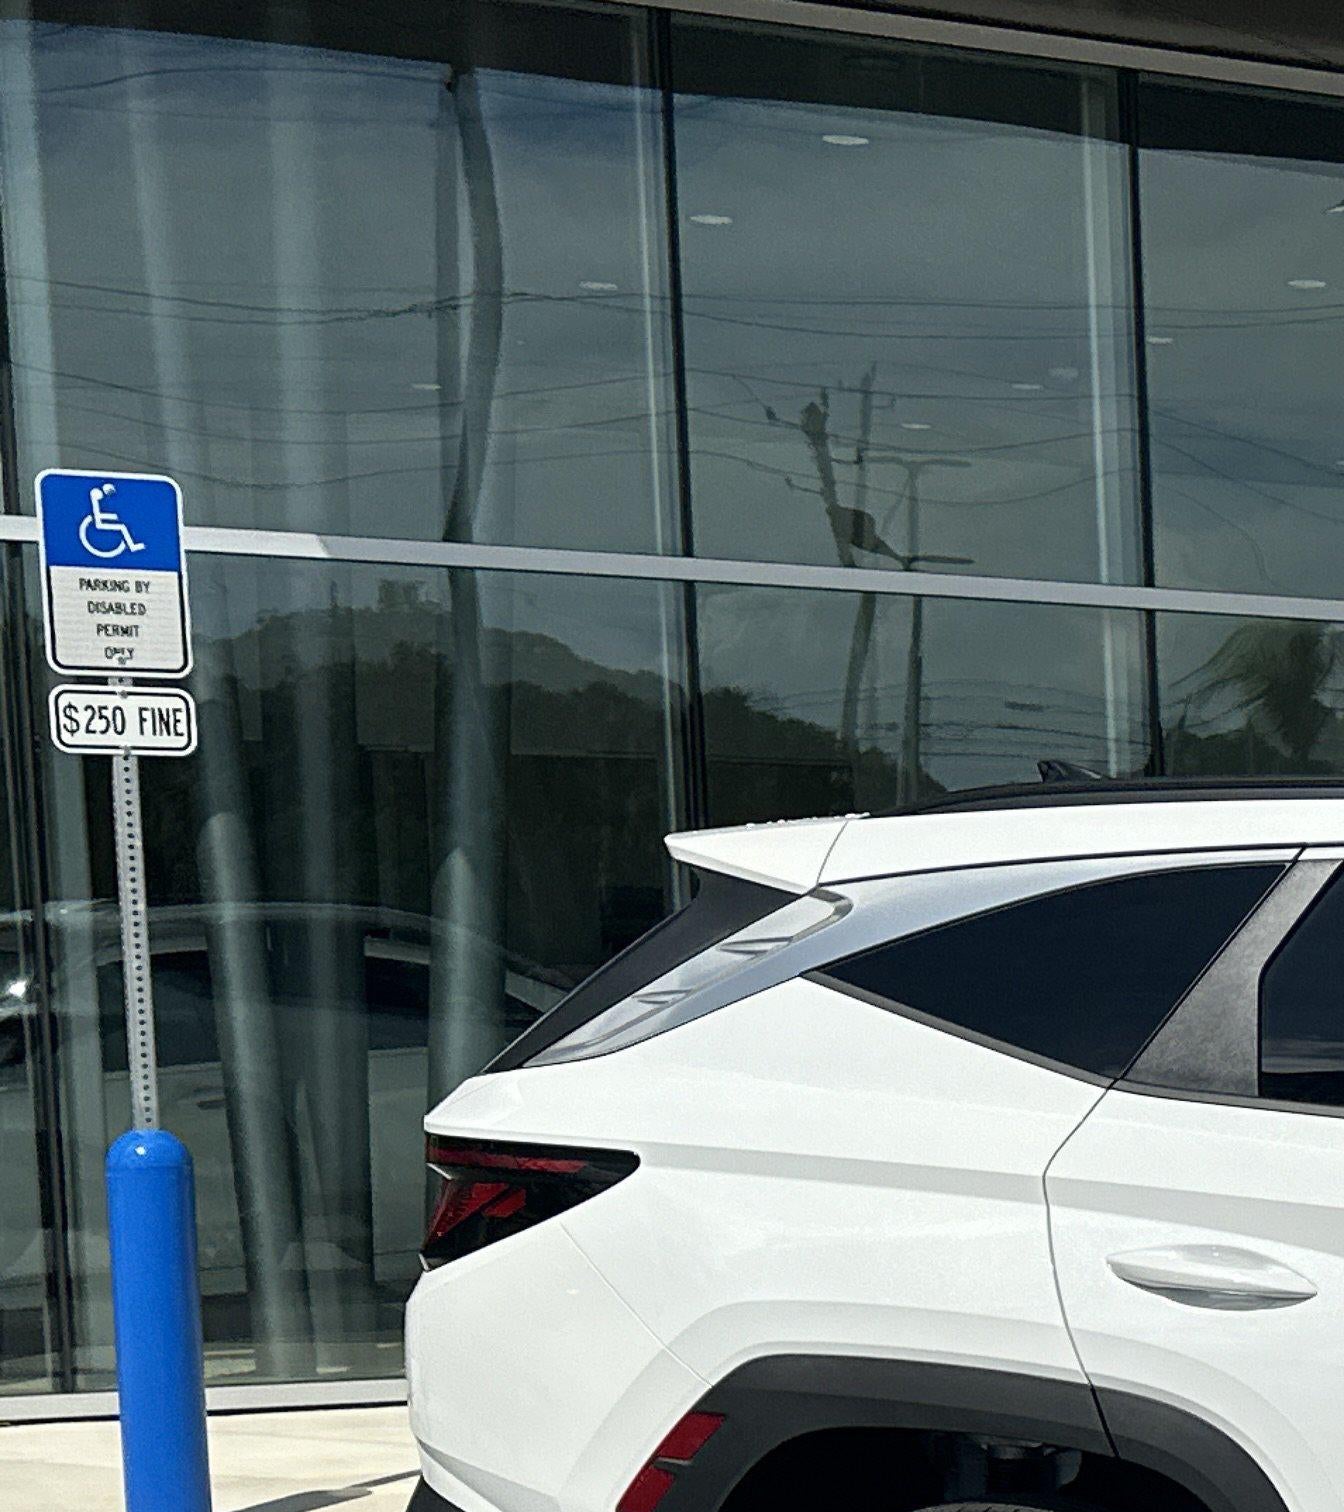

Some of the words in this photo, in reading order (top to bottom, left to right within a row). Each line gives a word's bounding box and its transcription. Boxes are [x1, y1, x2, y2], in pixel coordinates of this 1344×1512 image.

[78, 577, 131, 593] PARKING
[134, 579, 152, 593] BY
[87, 600, 147, 616] DISABLED
[96, 622, 140, 638] PERMIT
[62, 701, 127, 737] $250
[138, 706, 185, 737] FINE
